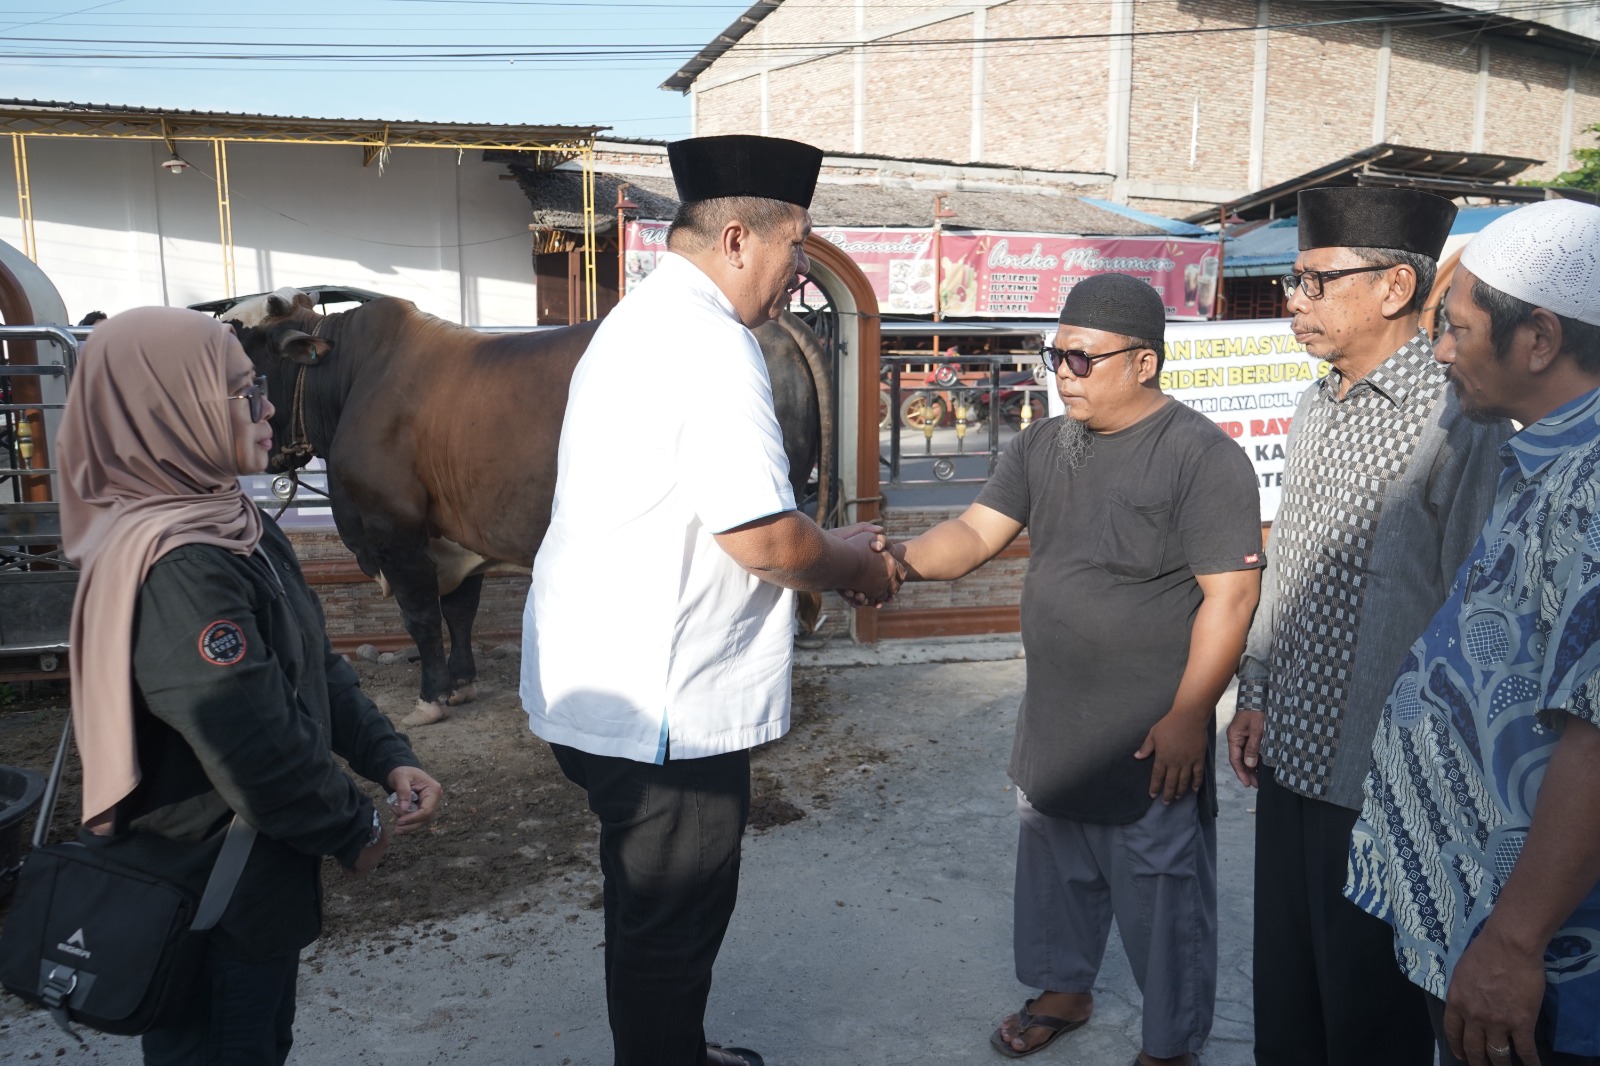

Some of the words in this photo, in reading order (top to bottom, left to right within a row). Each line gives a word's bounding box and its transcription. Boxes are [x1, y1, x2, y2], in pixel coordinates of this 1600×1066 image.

[989, 239, 1058, 269] Aneka
[1062, 247, 1175, 271] Minuman
[1007, 284, 1038, 292] TIMUN
[1227, 361, 1313, 386] BERUPA
[1220, 395, 1258, 411] RAYA
[1260, 392, 1294, 408] IDUL
